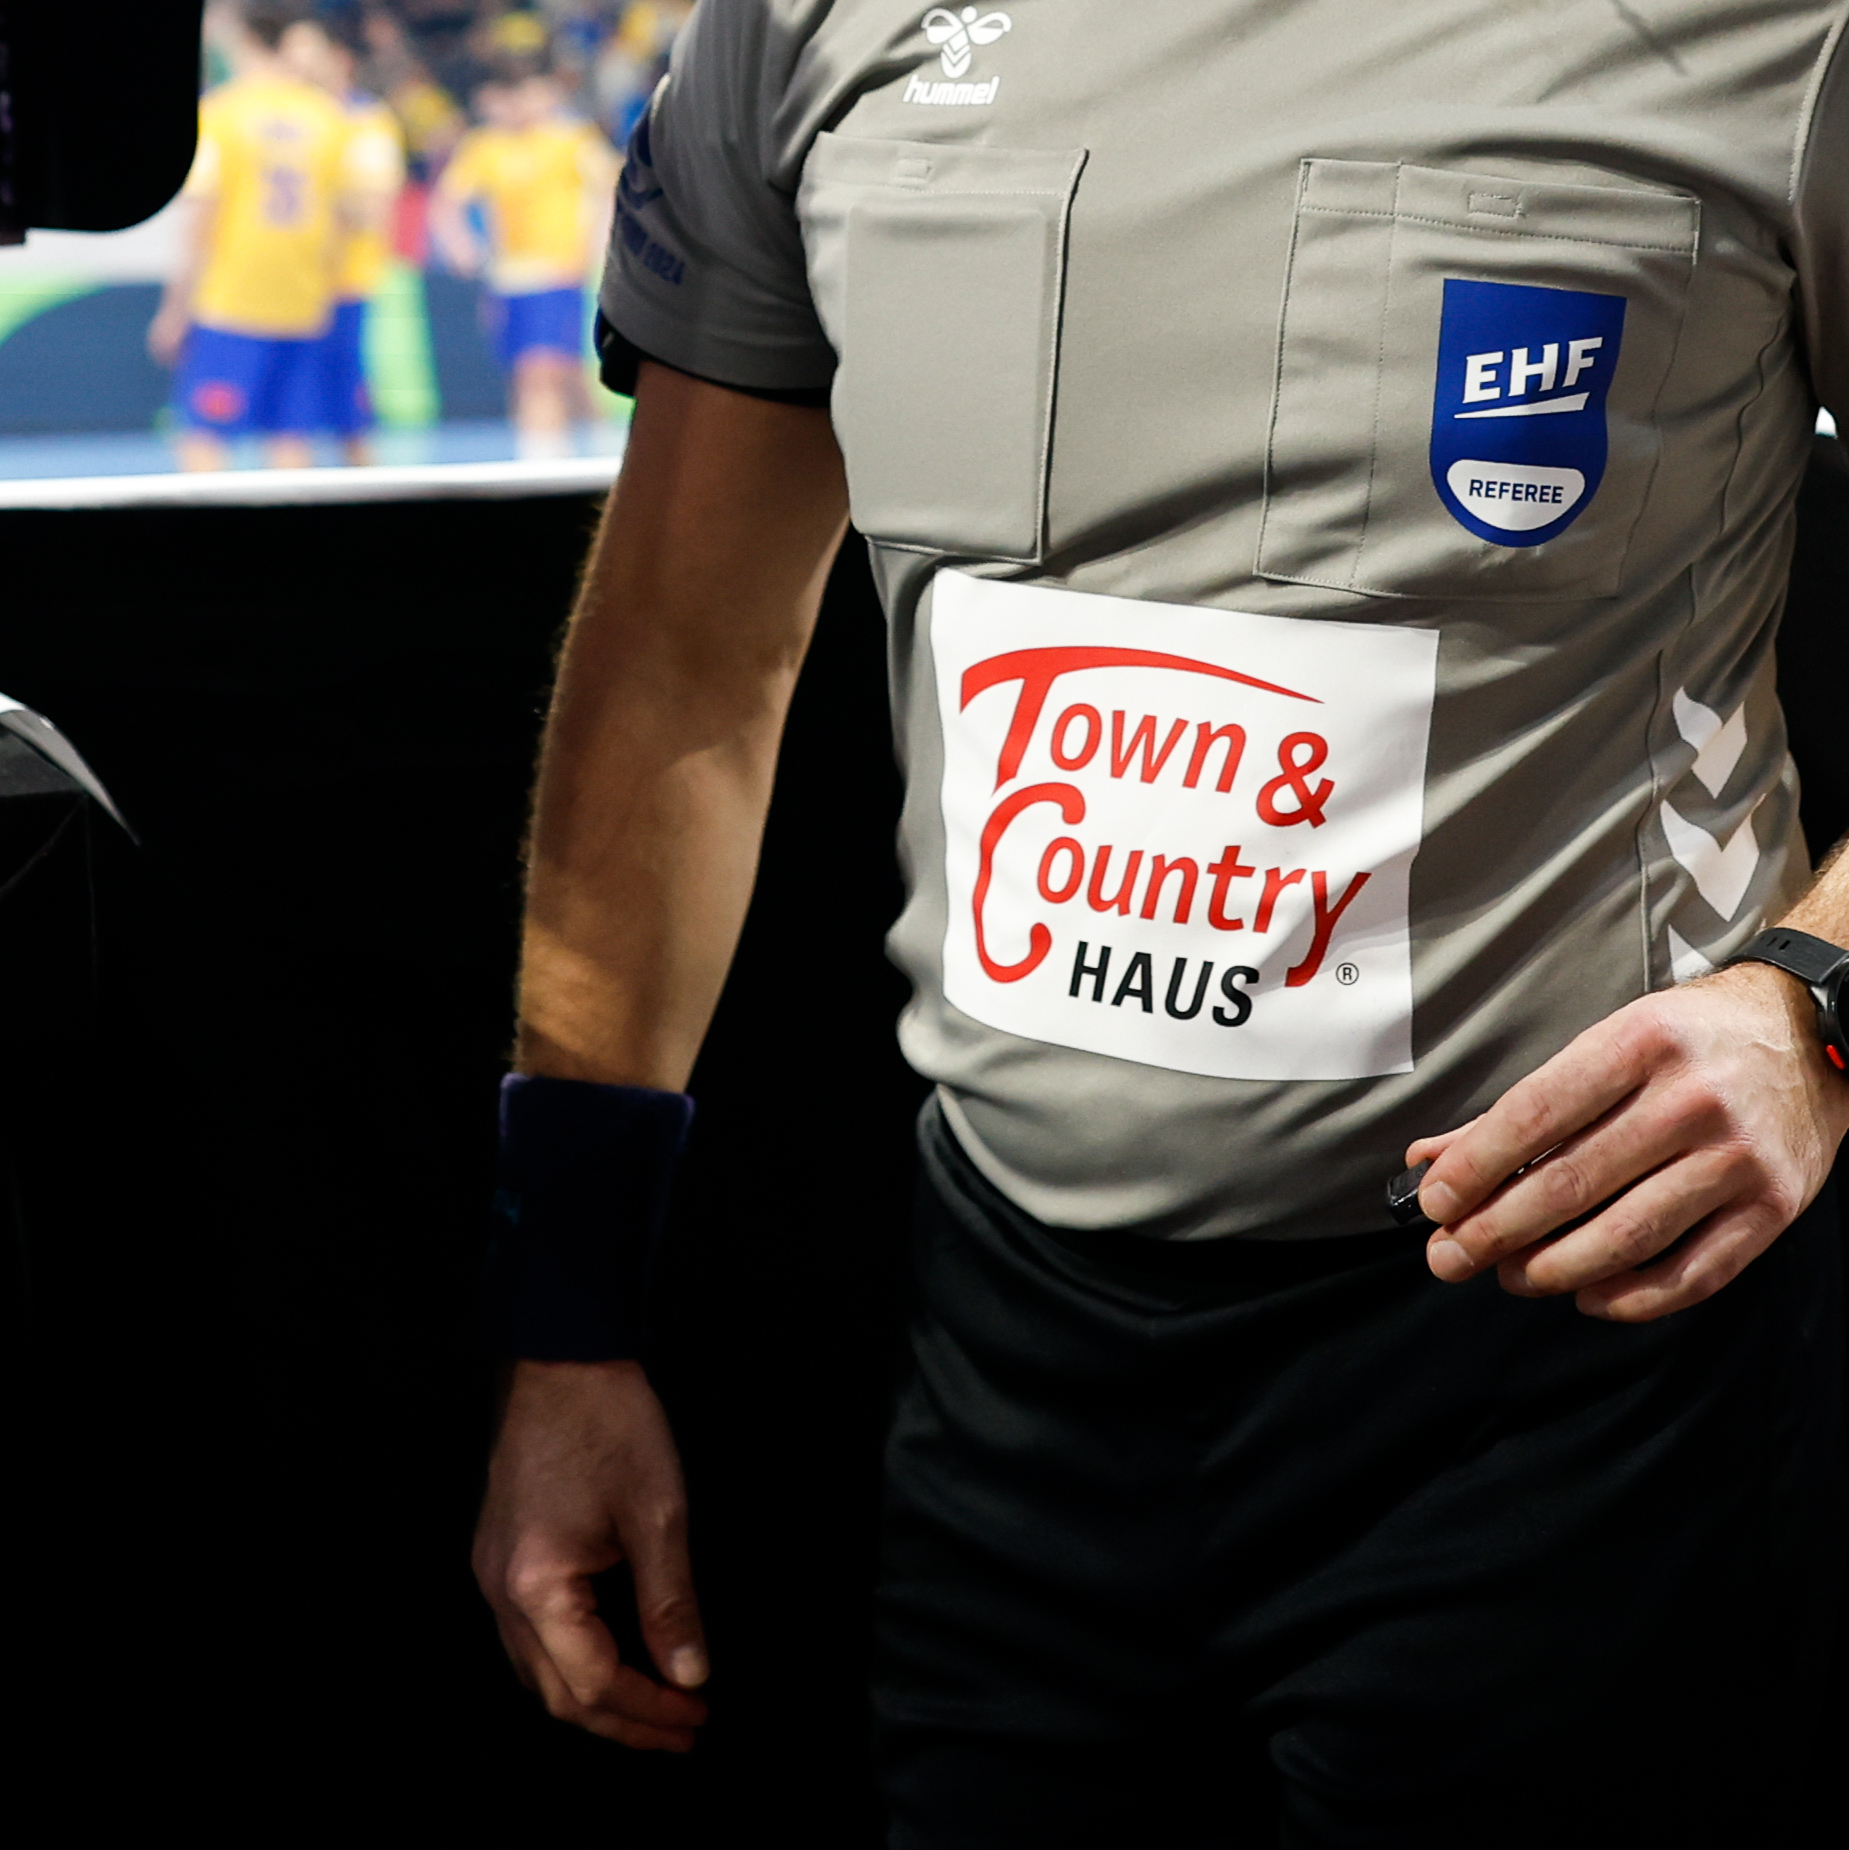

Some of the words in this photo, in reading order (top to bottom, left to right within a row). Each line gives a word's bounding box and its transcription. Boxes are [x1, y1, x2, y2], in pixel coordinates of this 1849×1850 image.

[902, 73, 1001, 106] hummel
[1461, 336, 1605, 404] EHF
[1468, 478, 1565, 505] REFEREE
[959, 644, 1325, 798] Town
[1255, 731, 1336, 829] &
[972, 781, 1372, 987] Country
[1067, 940, 1260, 1028] HAUS
